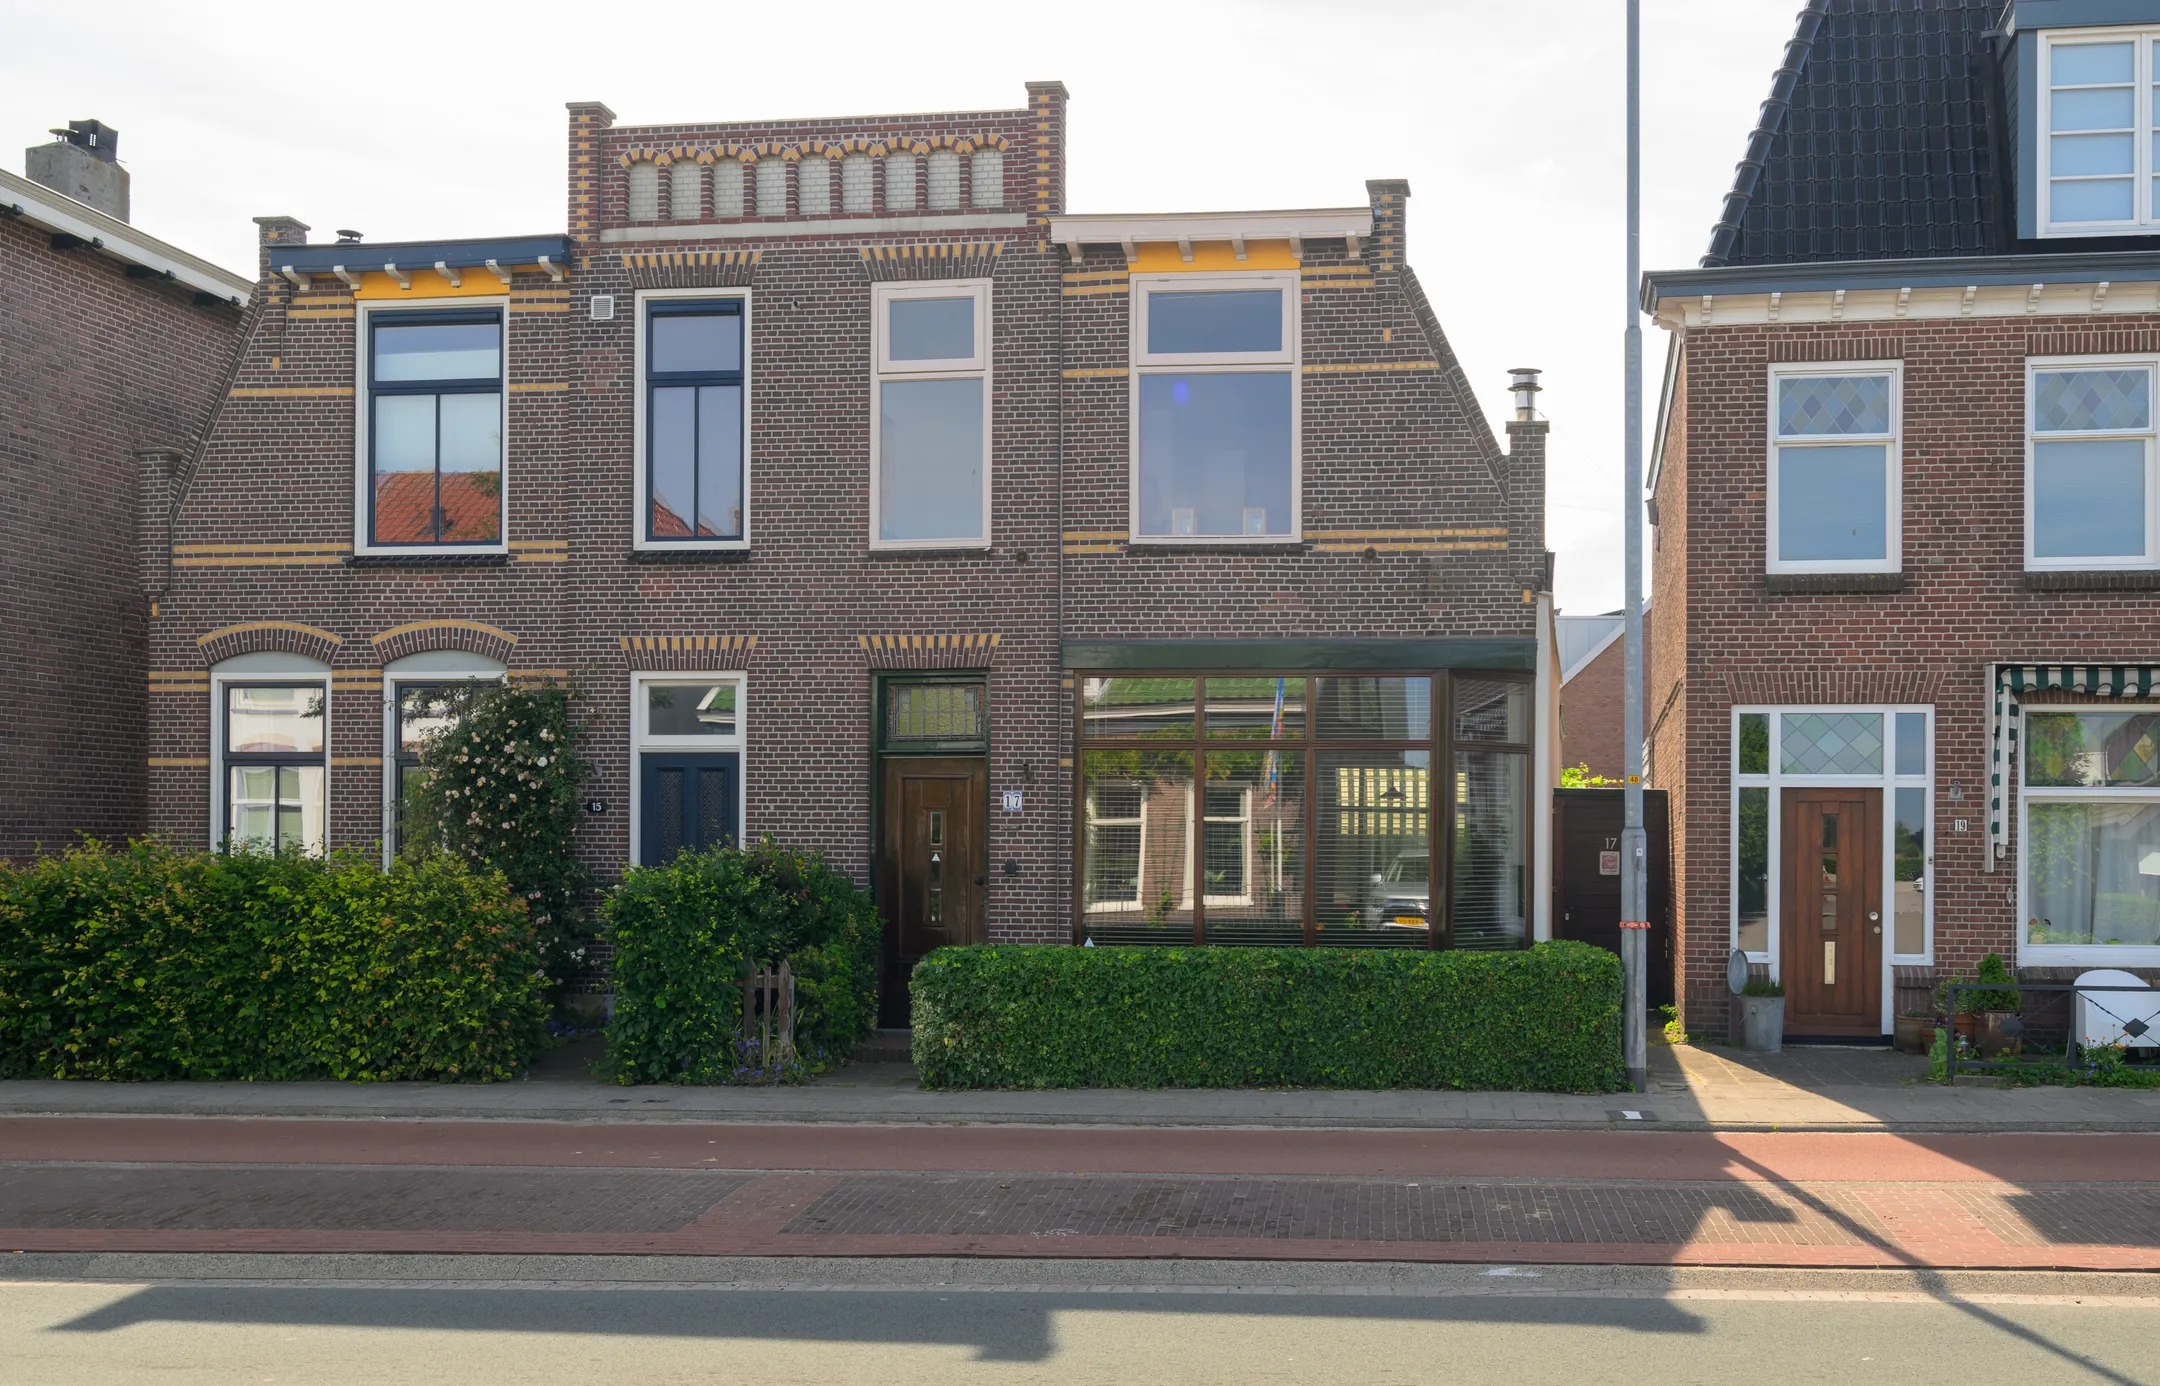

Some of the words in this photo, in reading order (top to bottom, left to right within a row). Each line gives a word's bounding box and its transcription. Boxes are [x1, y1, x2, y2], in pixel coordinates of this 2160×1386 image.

[592, 802, 602, 812] 15
[1006, 795, 1020, 808] 17
[1956, 820, 1966, 831] 19
[1605, 837, 1618, 850] 17
